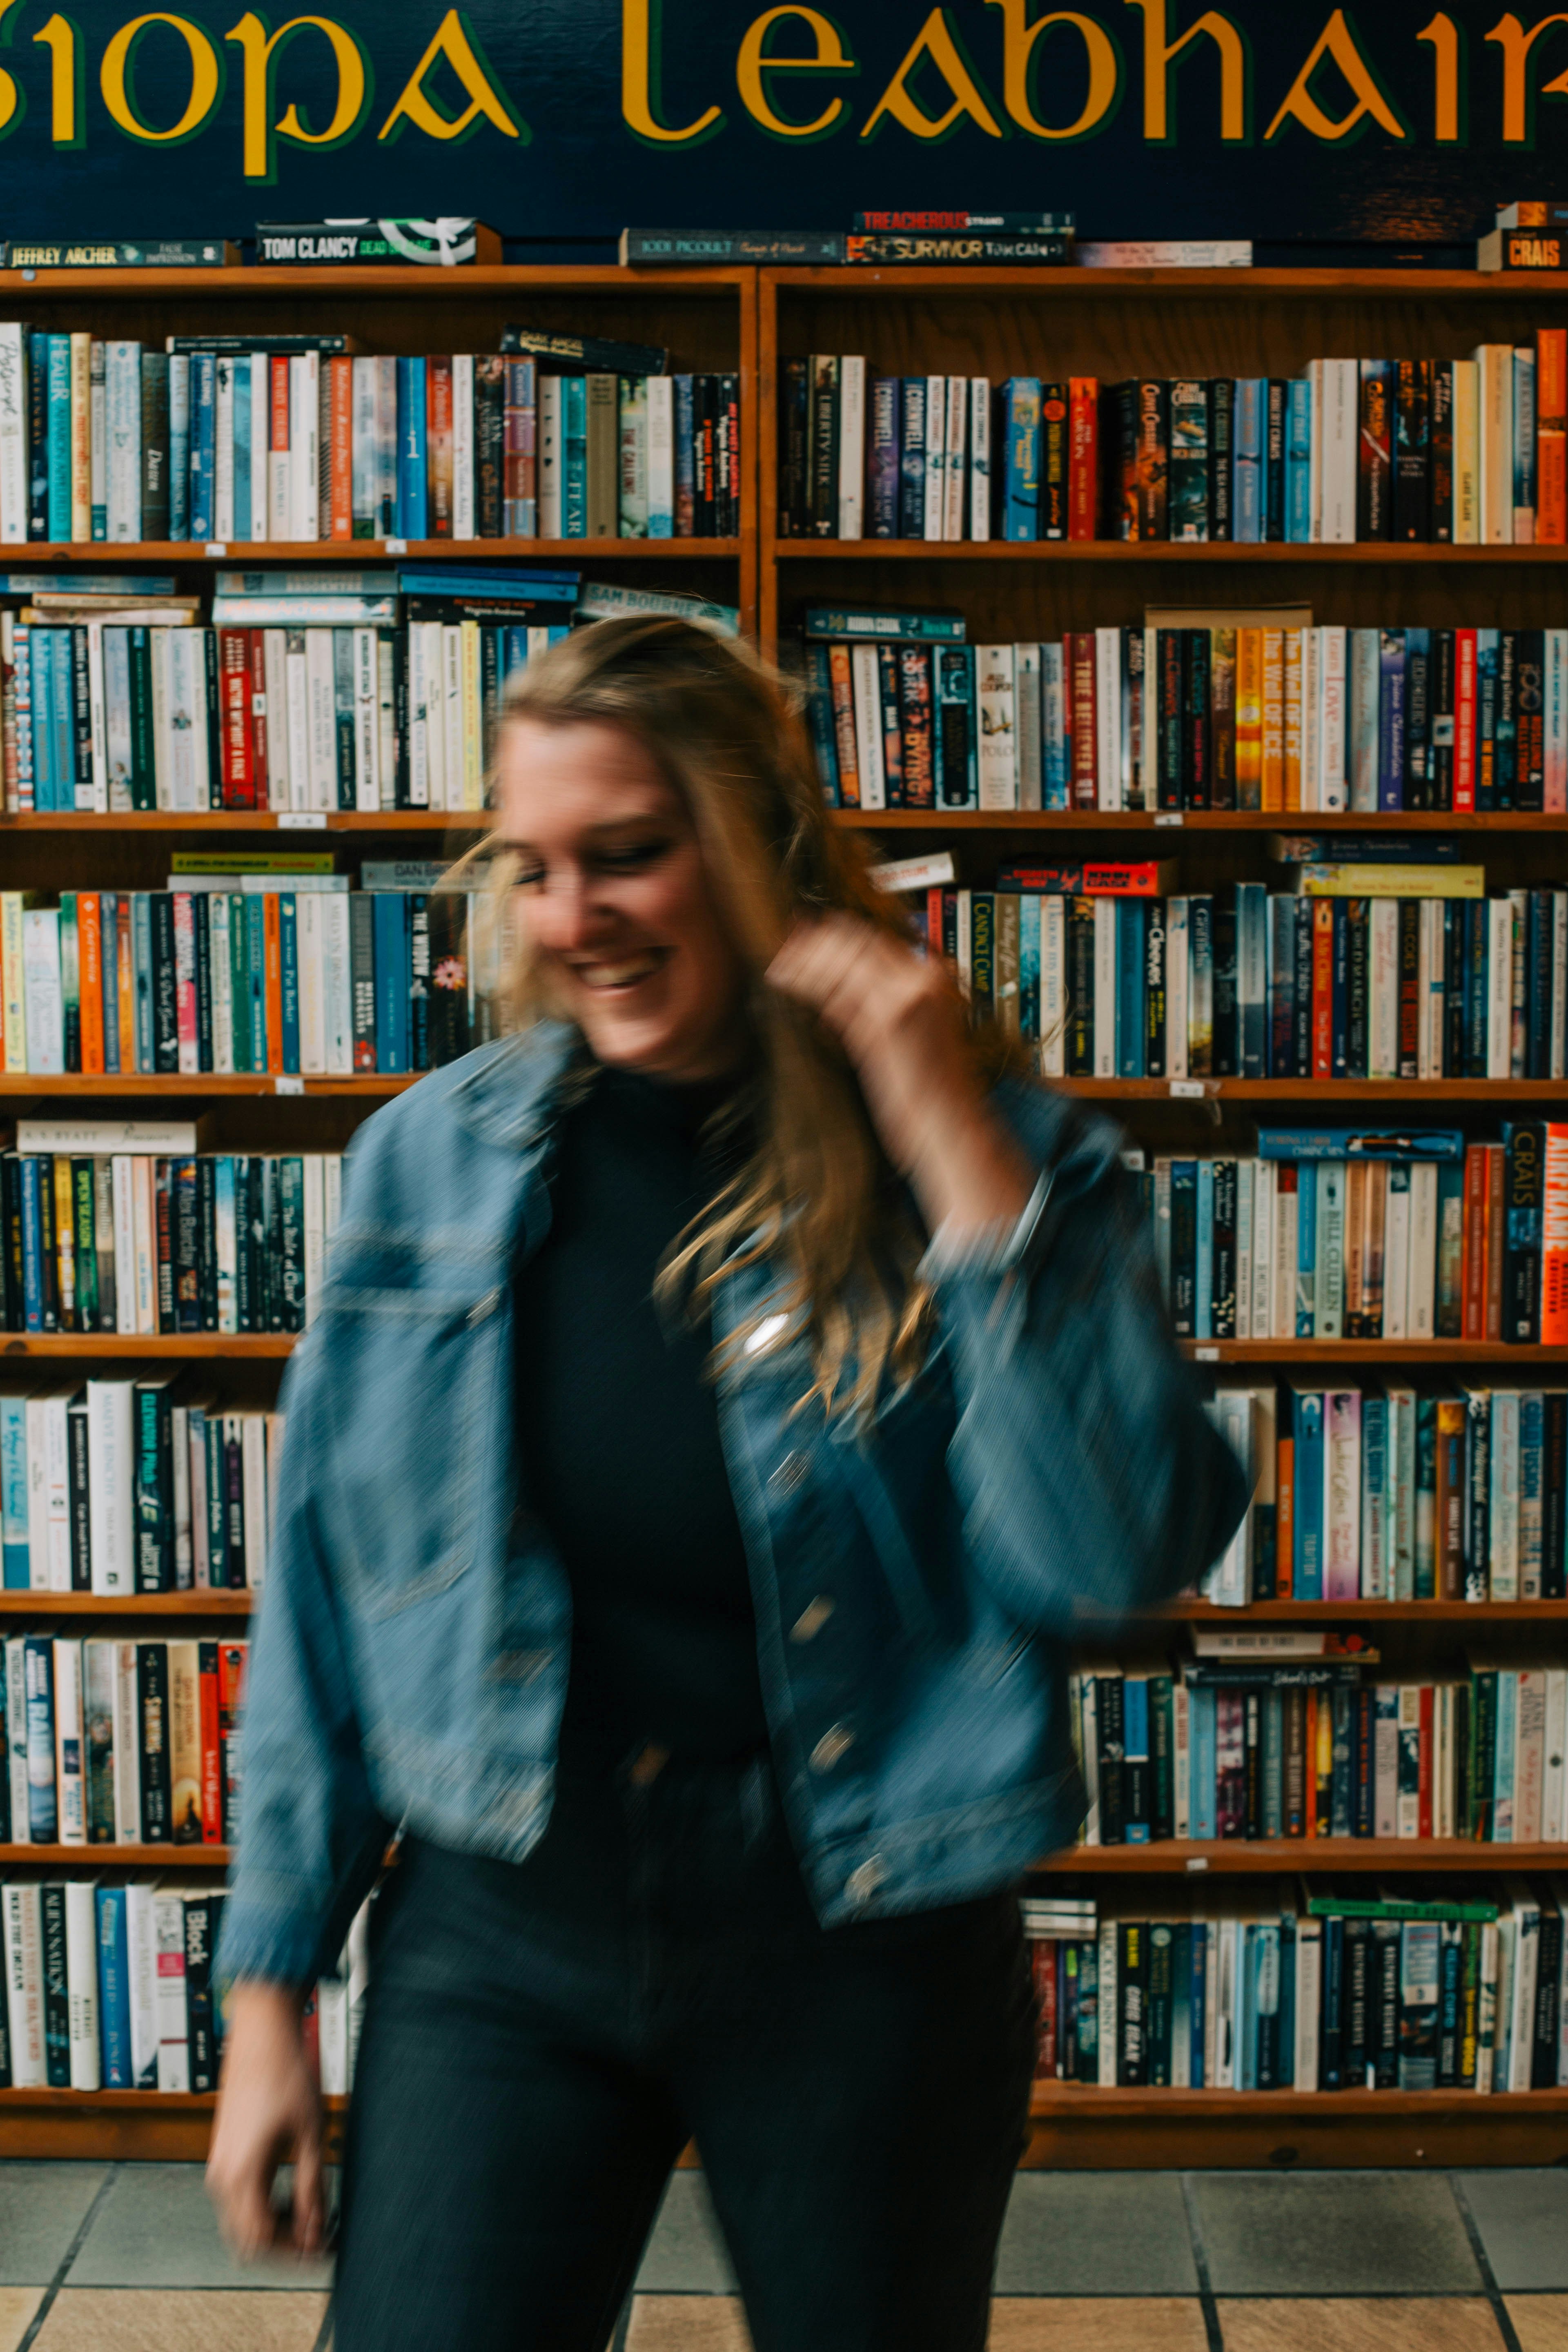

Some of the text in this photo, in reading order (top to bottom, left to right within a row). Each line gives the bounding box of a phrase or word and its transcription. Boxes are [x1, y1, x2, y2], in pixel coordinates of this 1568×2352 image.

[263, 237, 358, 259] TOM CLANCY
[863, 212, 969, 229] TREACHEROUS
[13, 247, 117, 267] JEFFREY ARCHER
[894, 240, 983, 258] SURVIVOR
[1509, 239, 1560, 265] CRAIS
[819, 395, 831, 486] LIBERTY SILK
[905, 387, 924, 451] CORNWELL
[1265, 632, 1281, 659] The
[1287, 632, 1300, 659] The
[1166, 661, 1180, 716] Cleeves
[1192, 659, 1204, 715] Cleeves
[1325, 677, 1344, 722] Love
[1501, 636, 1515, 722] breaking silence
[1074, 660, 1092, 770] TRUE BELIEVER
[1264, 731, 1281, 759] ICE
[1287, 731, 1300, 759] ICE
[413, 912, 430, 976] THE WIDOW
[974, 903, 991, 992] CANDACE CAMP
[1047, 911, 1060, 947] know
[1148, 927, 1164, 985] Cleeves
[1046, 952, 1060, 971] my
[1513, 1131, 1536, 1205] CRAIS
[1546, 1136, 1568, 1252] AIRFRAME
[77, 1171, 91, 1248] OPEN SEASON
[176, 1187, 196, 1267] Alex Barclay
[285, 1227, 297, 1257] Rule
[1327, 1210, 1341, 1312] BILL CULLEN
[160, 1263, 173, 1312] RESTLESS
[185, 1909, 208, 1967] Block
